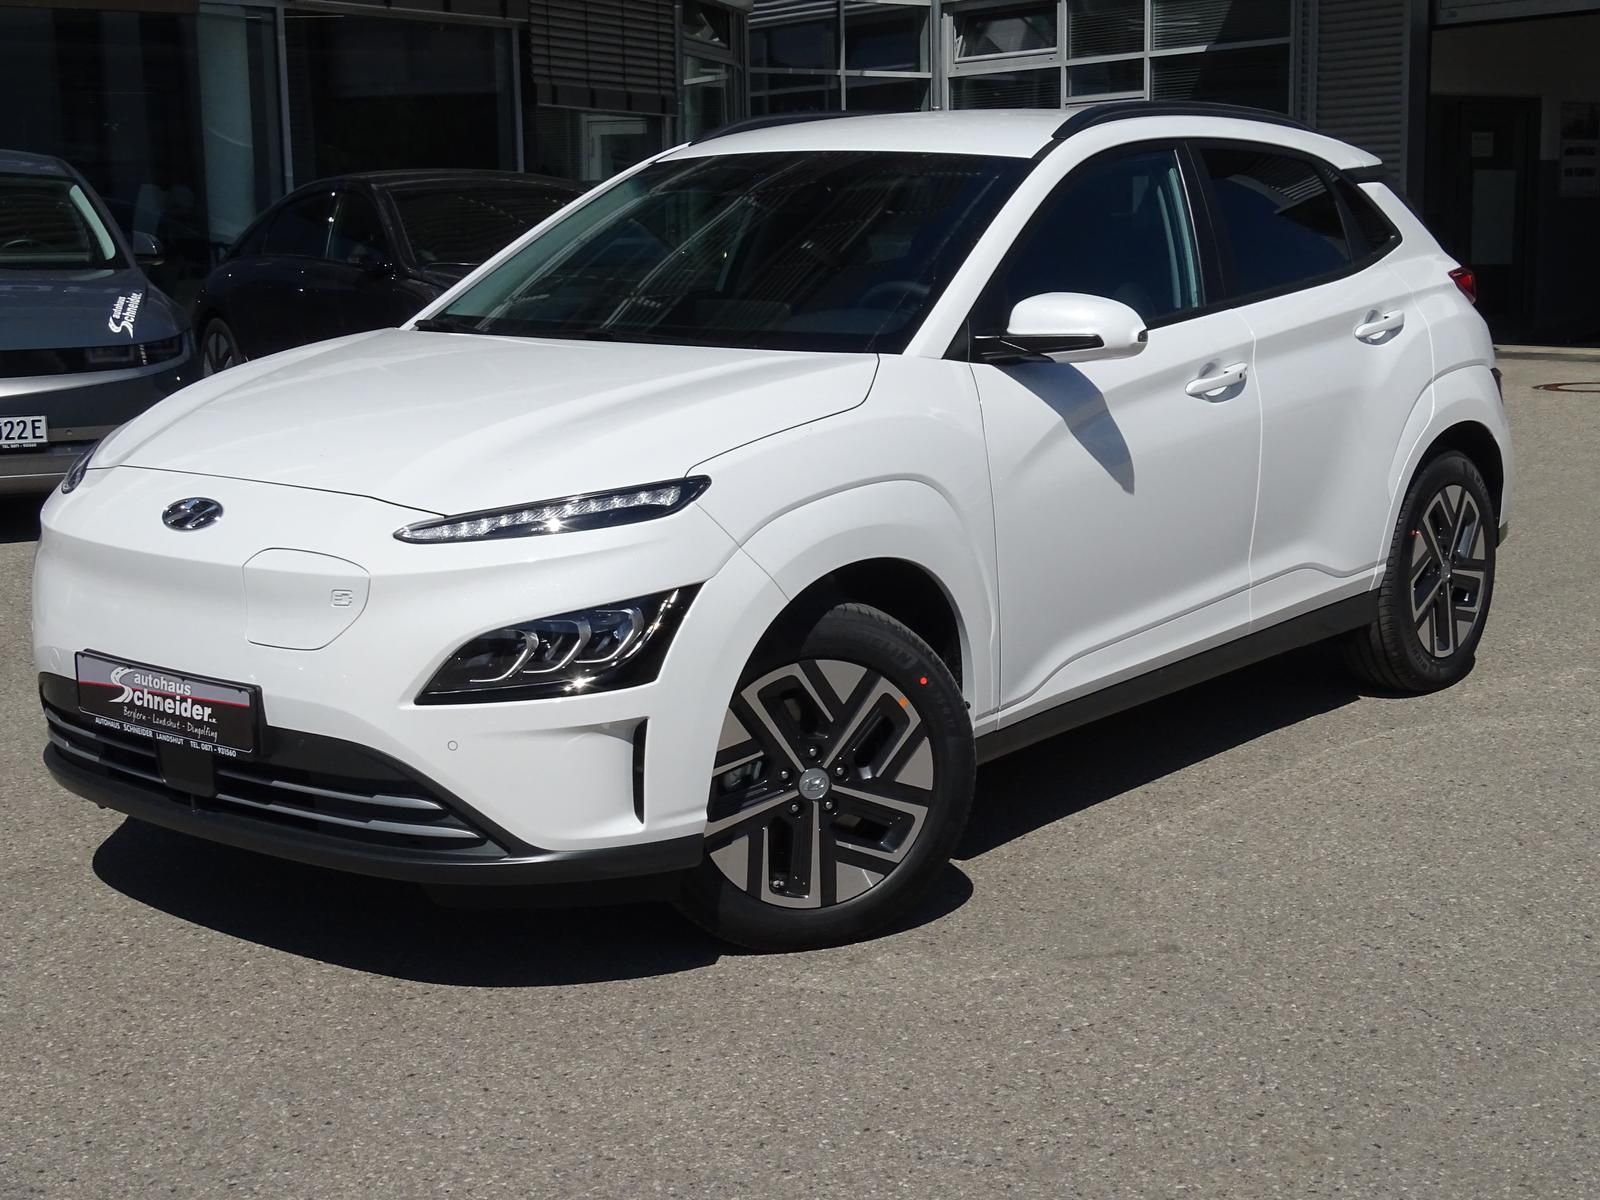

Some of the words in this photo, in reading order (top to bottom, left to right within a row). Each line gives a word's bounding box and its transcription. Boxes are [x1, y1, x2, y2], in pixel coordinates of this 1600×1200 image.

[134, 673, 191, 696] autohaus
[95, 716, 120, 730] AUTOHAUS
[123, 723, 153, 738] SCHNEIDER
[156, 732, 184, 745] LANDSHUT
[200, 743, 213, 752] 0871
[152, 713, 180, 730] Landshut
[187, 721, 218, 743] Dingolfing
